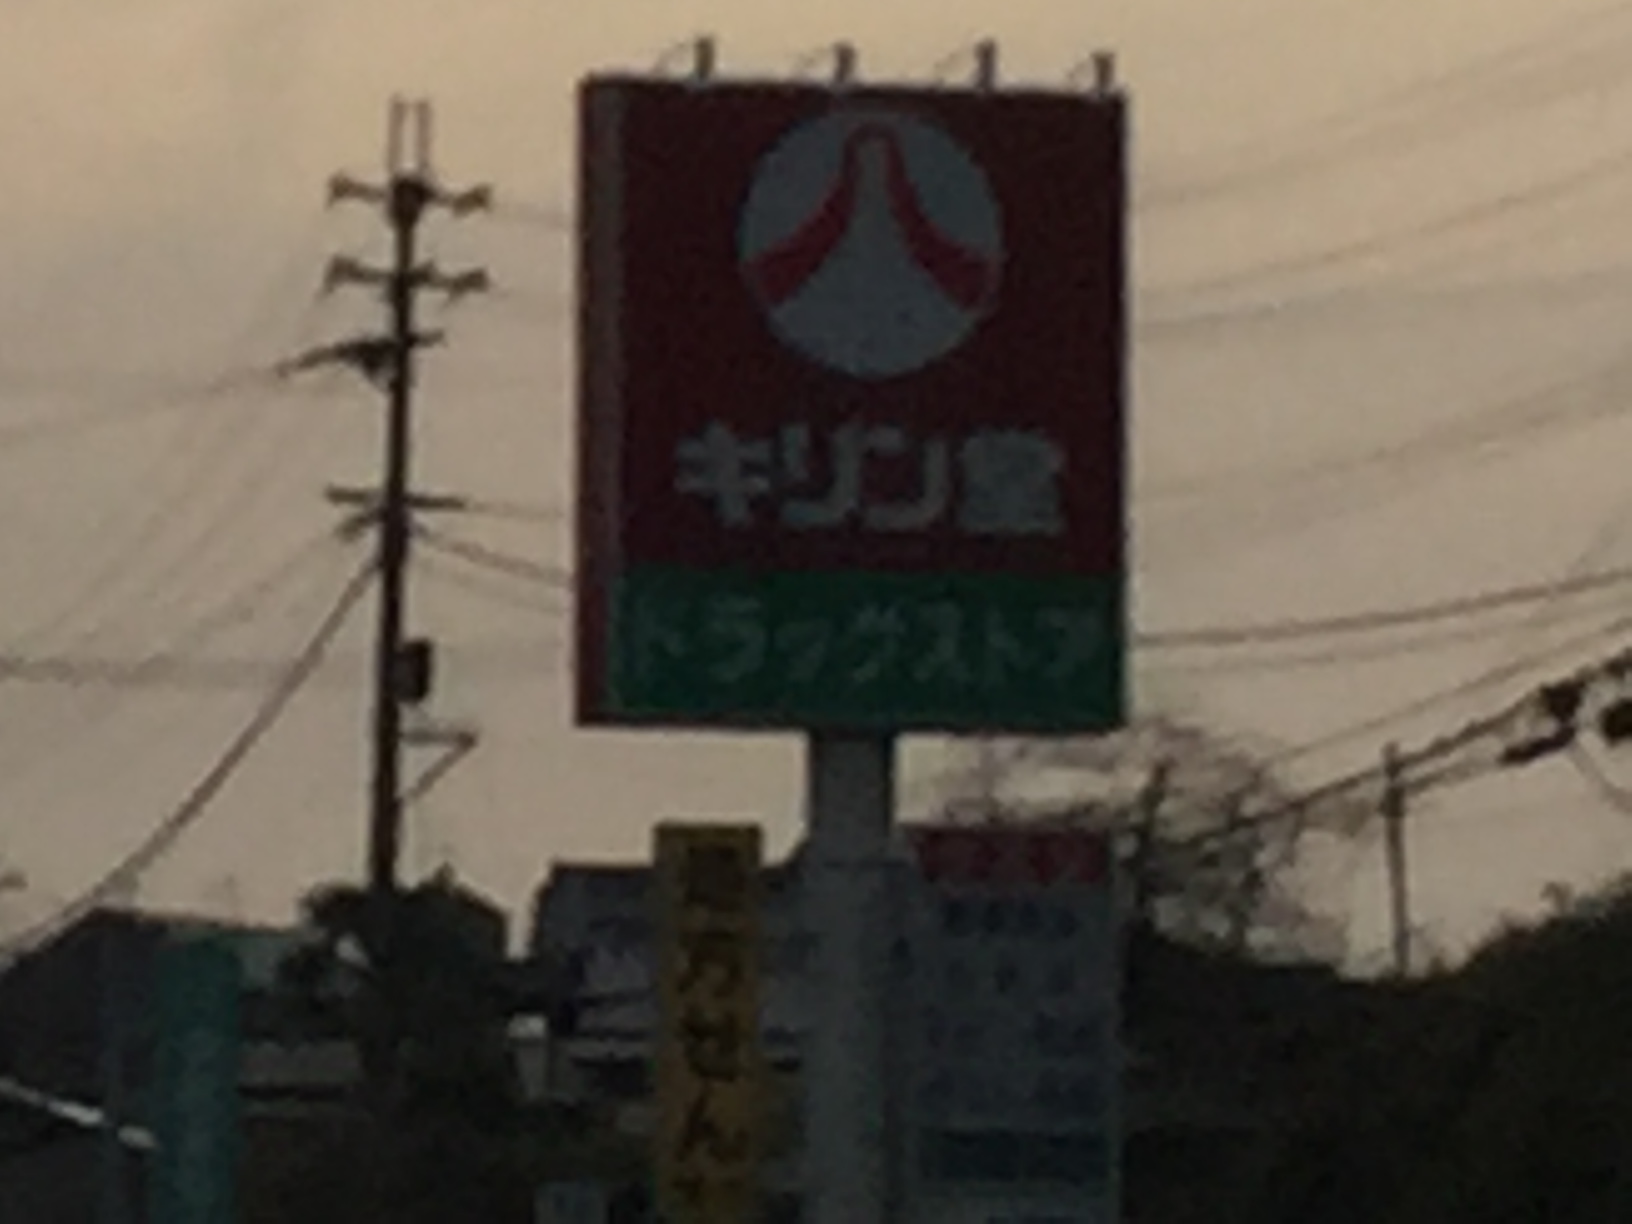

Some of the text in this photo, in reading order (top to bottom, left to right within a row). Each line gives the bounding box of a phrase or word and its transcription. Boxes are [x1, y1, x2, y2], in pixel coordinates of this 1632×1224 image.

[632, 595, 1104, 685] ドラッグストア
